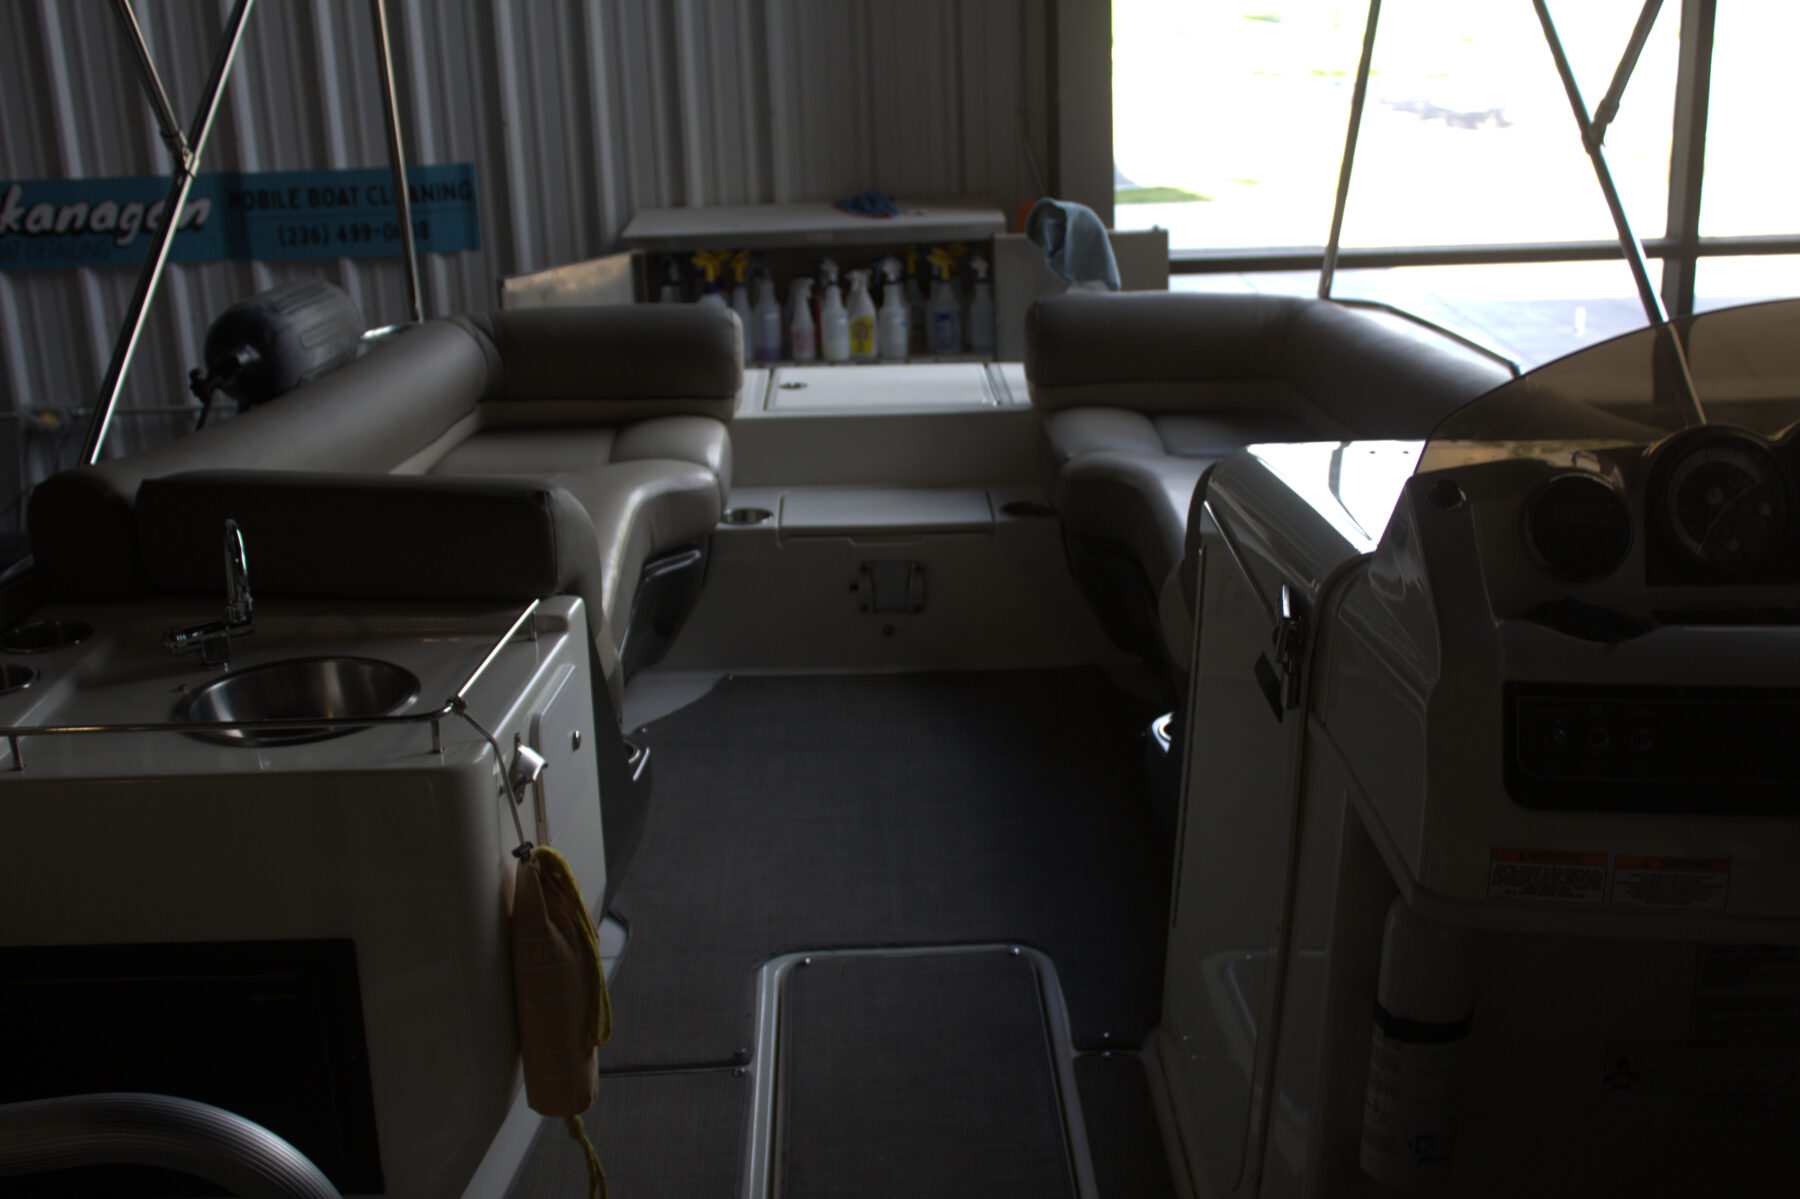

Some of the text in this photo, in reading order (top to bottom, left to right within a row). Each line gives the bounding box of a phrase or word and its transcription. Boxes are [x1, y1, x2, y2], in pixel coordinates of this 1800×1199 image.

[227, 180, 474, 211] MOBILE BOAT CLANING
[278, 220, 430, 248] (236) 499-08
